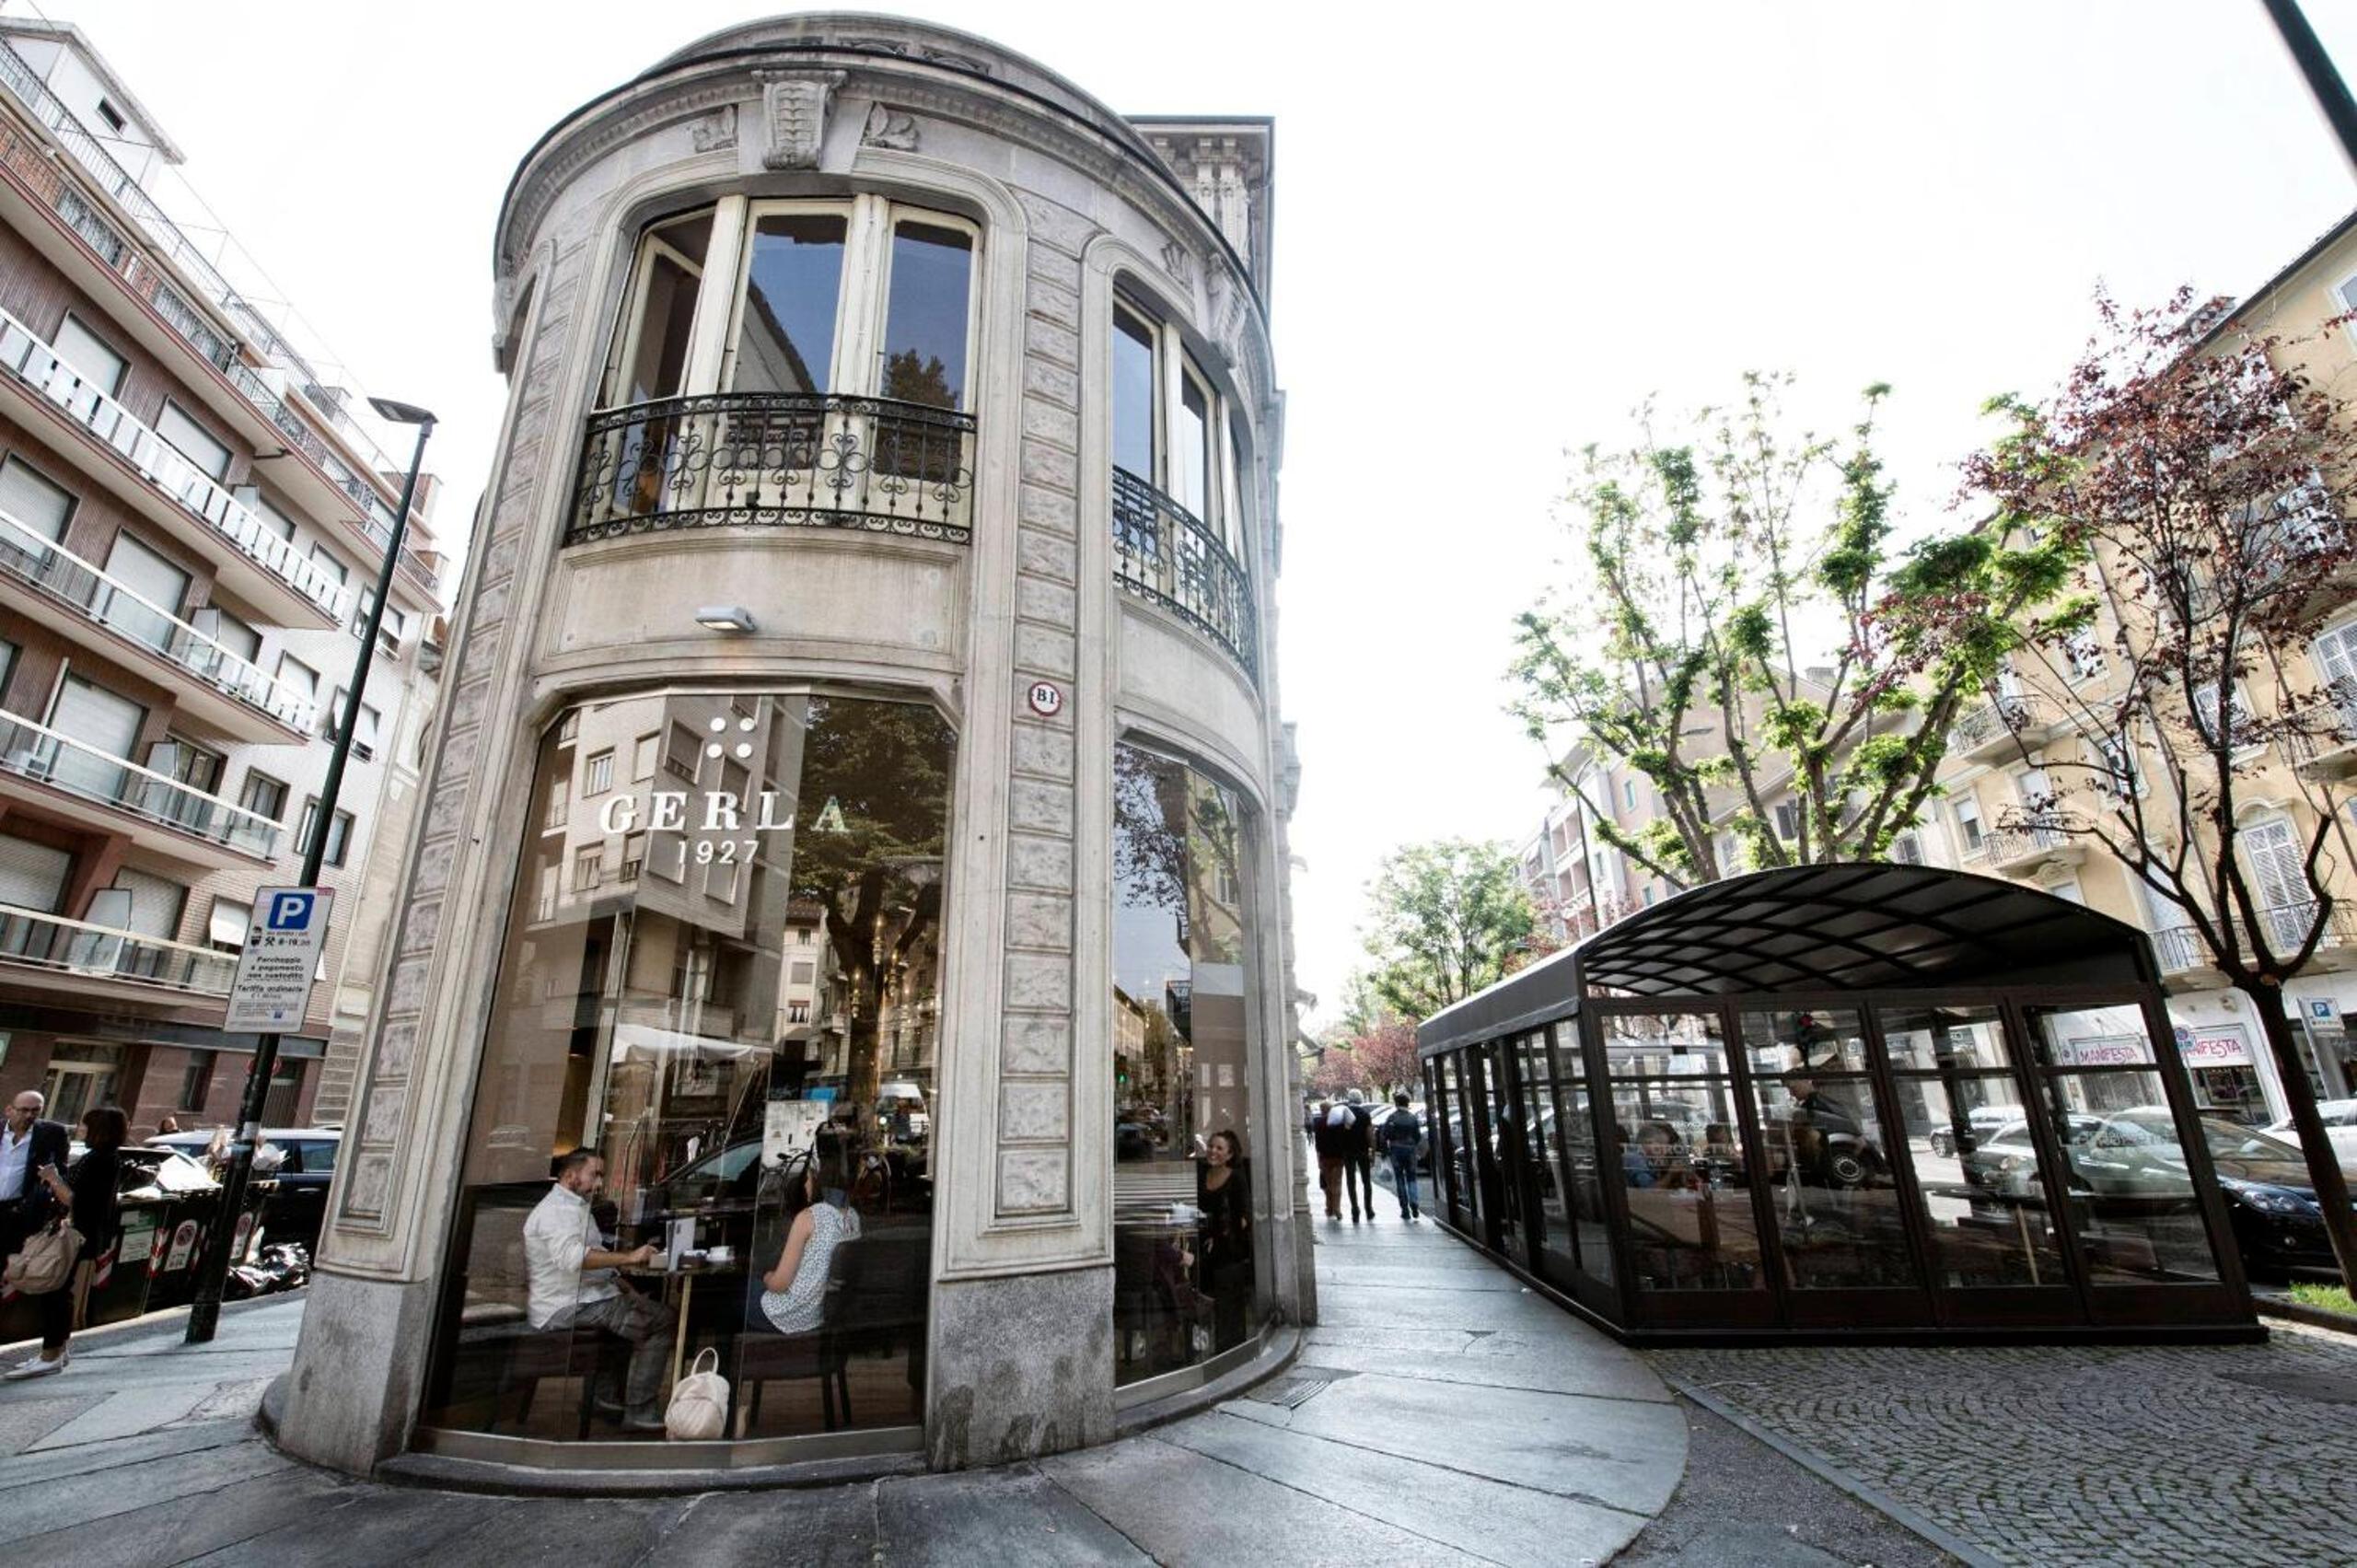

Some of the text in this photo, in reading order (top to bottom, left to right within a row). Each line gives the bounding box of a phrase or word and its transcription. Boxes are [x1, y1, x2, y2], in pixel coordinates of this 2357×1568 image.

[598, 790, 851, 834] GERLA
[678, 840, 761, 865] 1927
[276, 897, 306, 926] P
[2079, 1046, 2138, 1063] MANIFESTA
